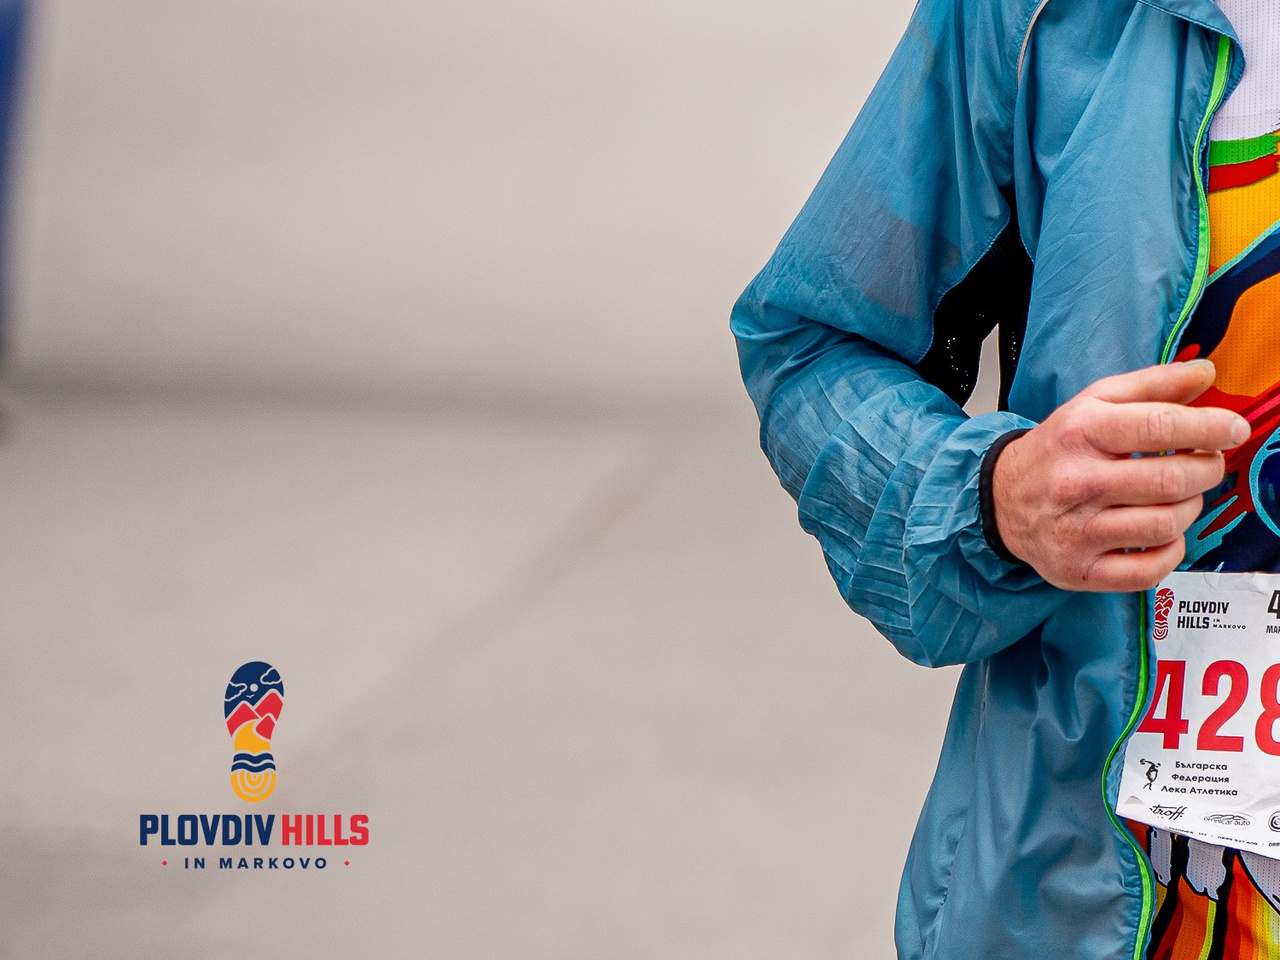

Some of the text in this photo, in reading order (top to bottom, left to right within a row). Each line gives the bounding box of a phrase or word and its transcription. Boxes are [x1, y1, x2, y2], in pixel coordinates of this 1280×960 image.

[1178, 600, 1230, 614] PLOVDIV
[1177, 615, 1210, 629] HILLS
[1174, 761, 1228, 771] Българска
[1171, 773, 1230, 783] Федерация
[1160, 785, 1238, 796] Лека Атлетика
